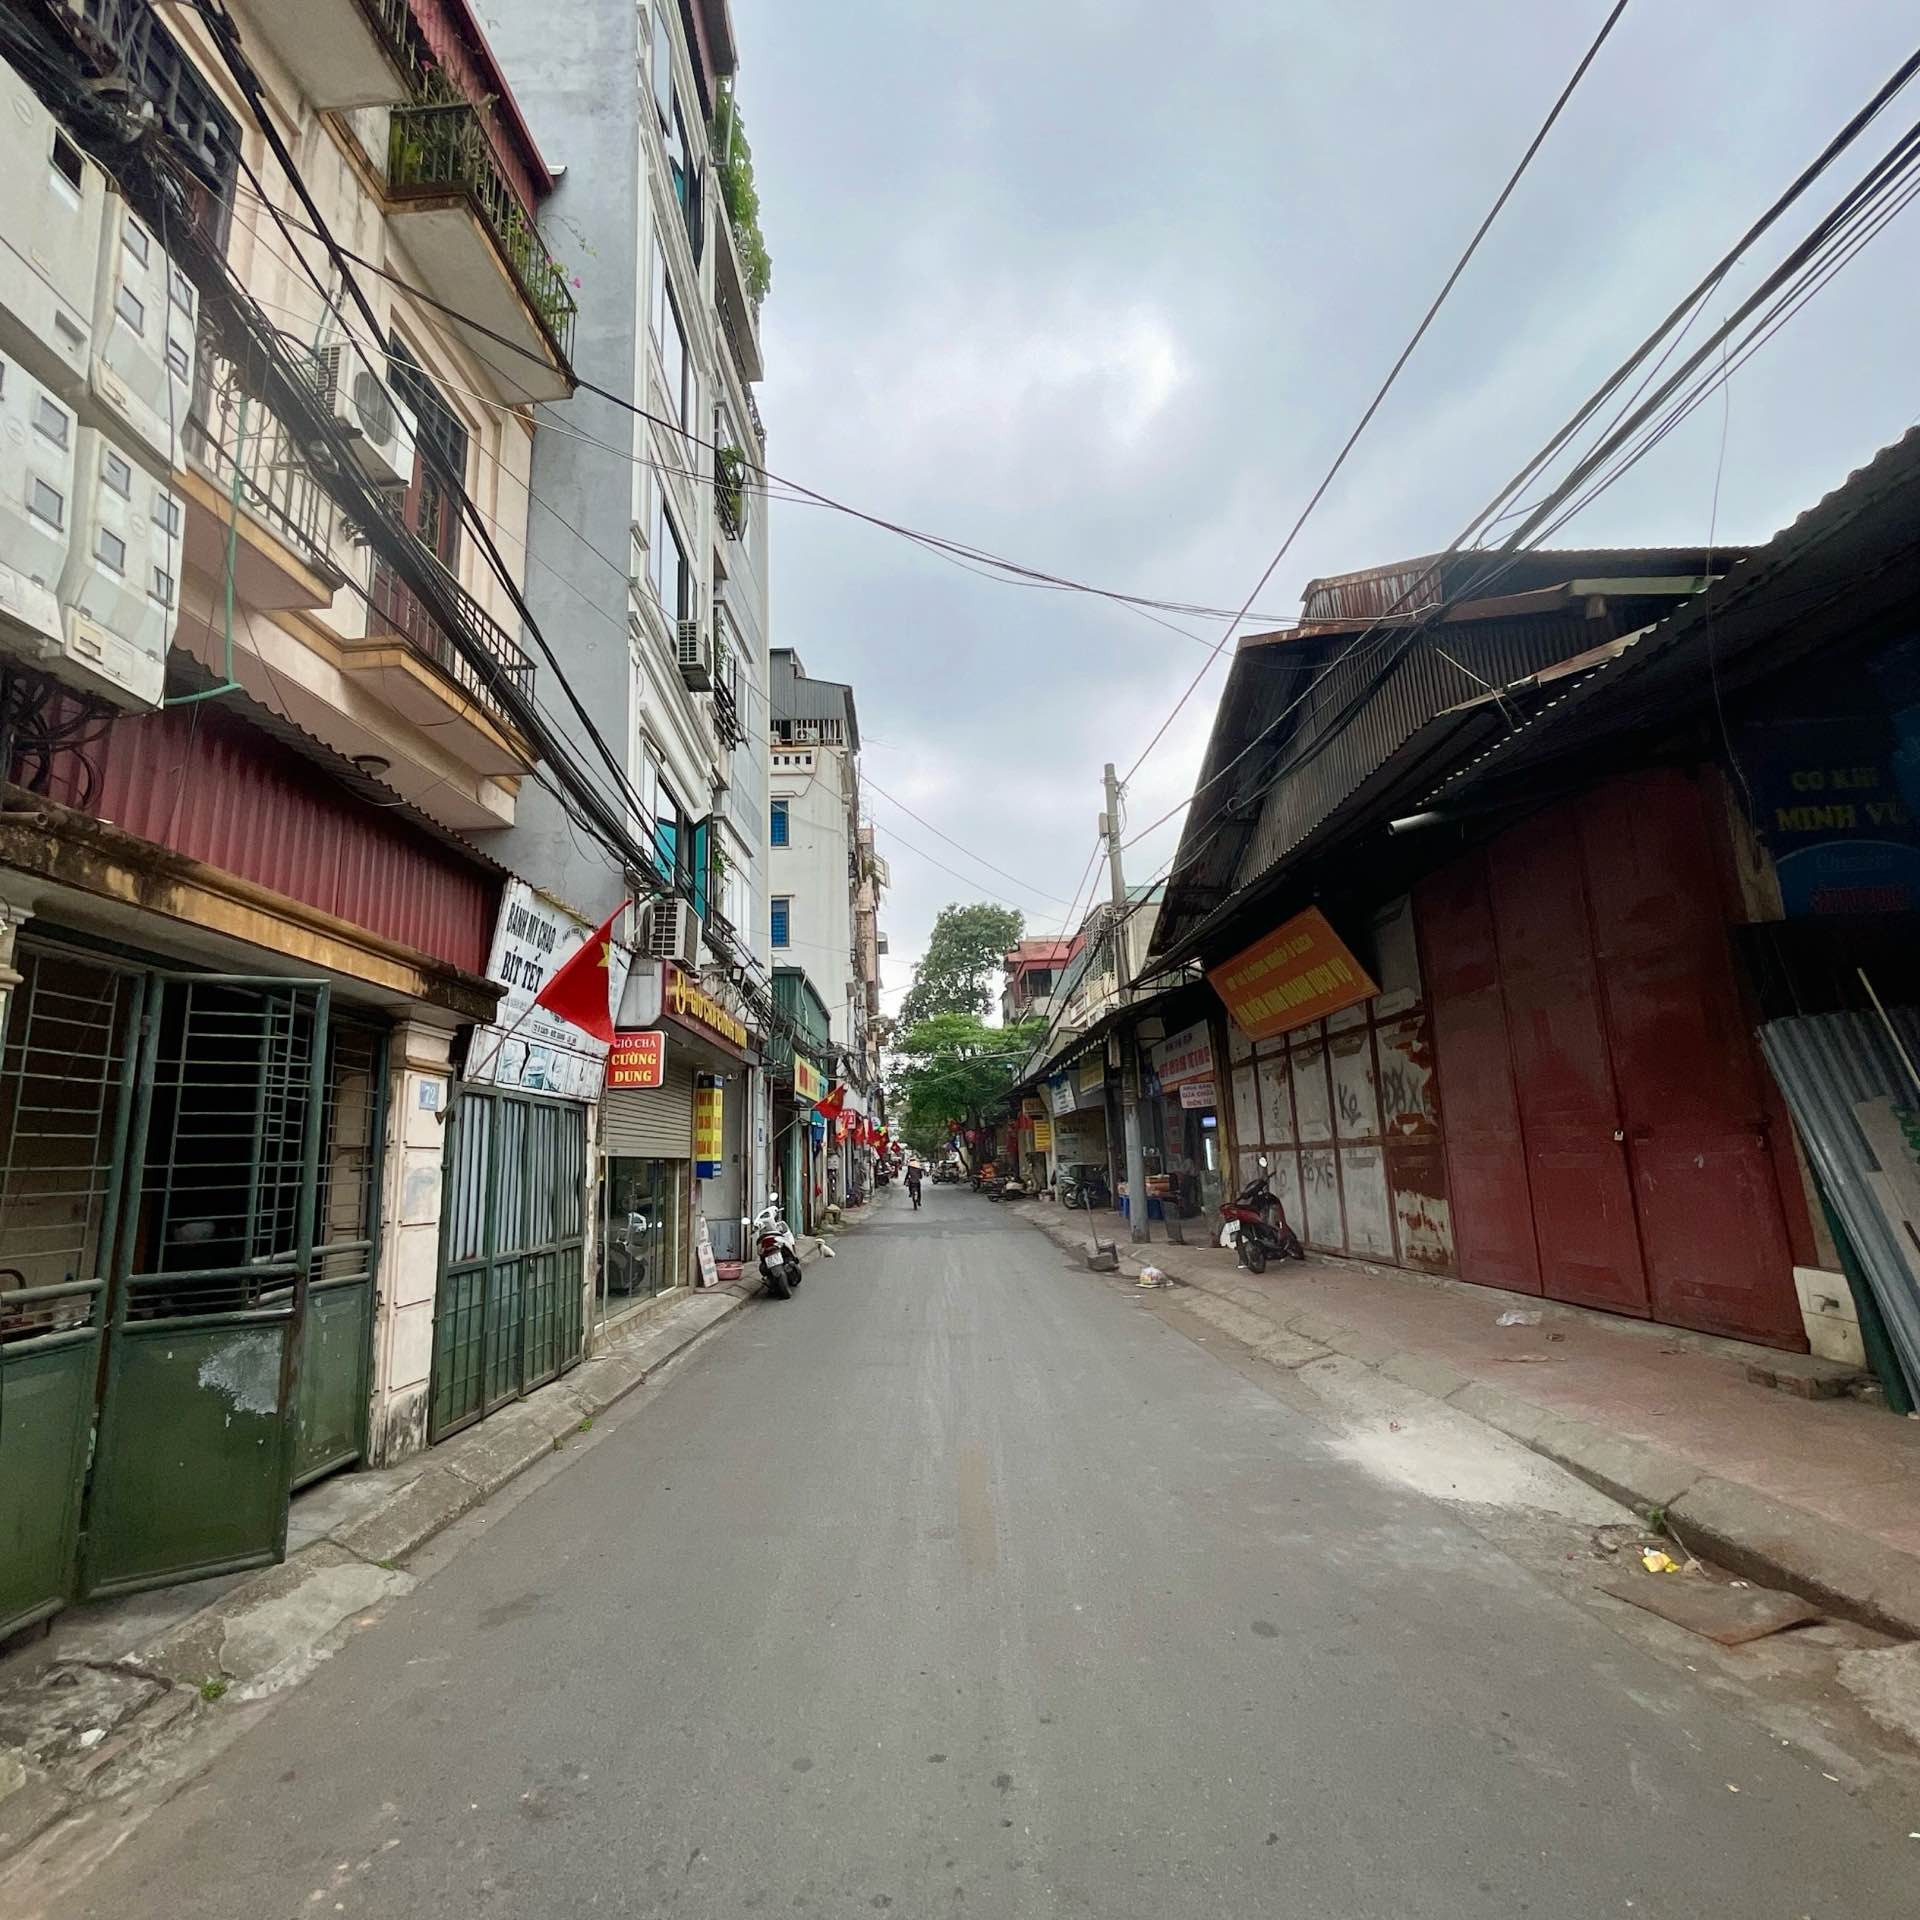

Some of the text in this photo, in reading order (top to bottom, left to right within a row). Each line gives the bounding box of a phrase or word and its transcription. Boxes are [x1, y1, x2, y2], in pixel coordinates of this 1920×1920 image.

[507, 900, 529, 939] BÁNH
[537, 914, 557, 955] CHẢO
[500, 946, 523, 985] BÍT
[634, 1037, 656, 1048] CHẢ
[611, 1051, 657, 1065] CƯỜNG
[614, 1070, 652, 1082] DUNG
[423, 1085, 436, 1105] 72
